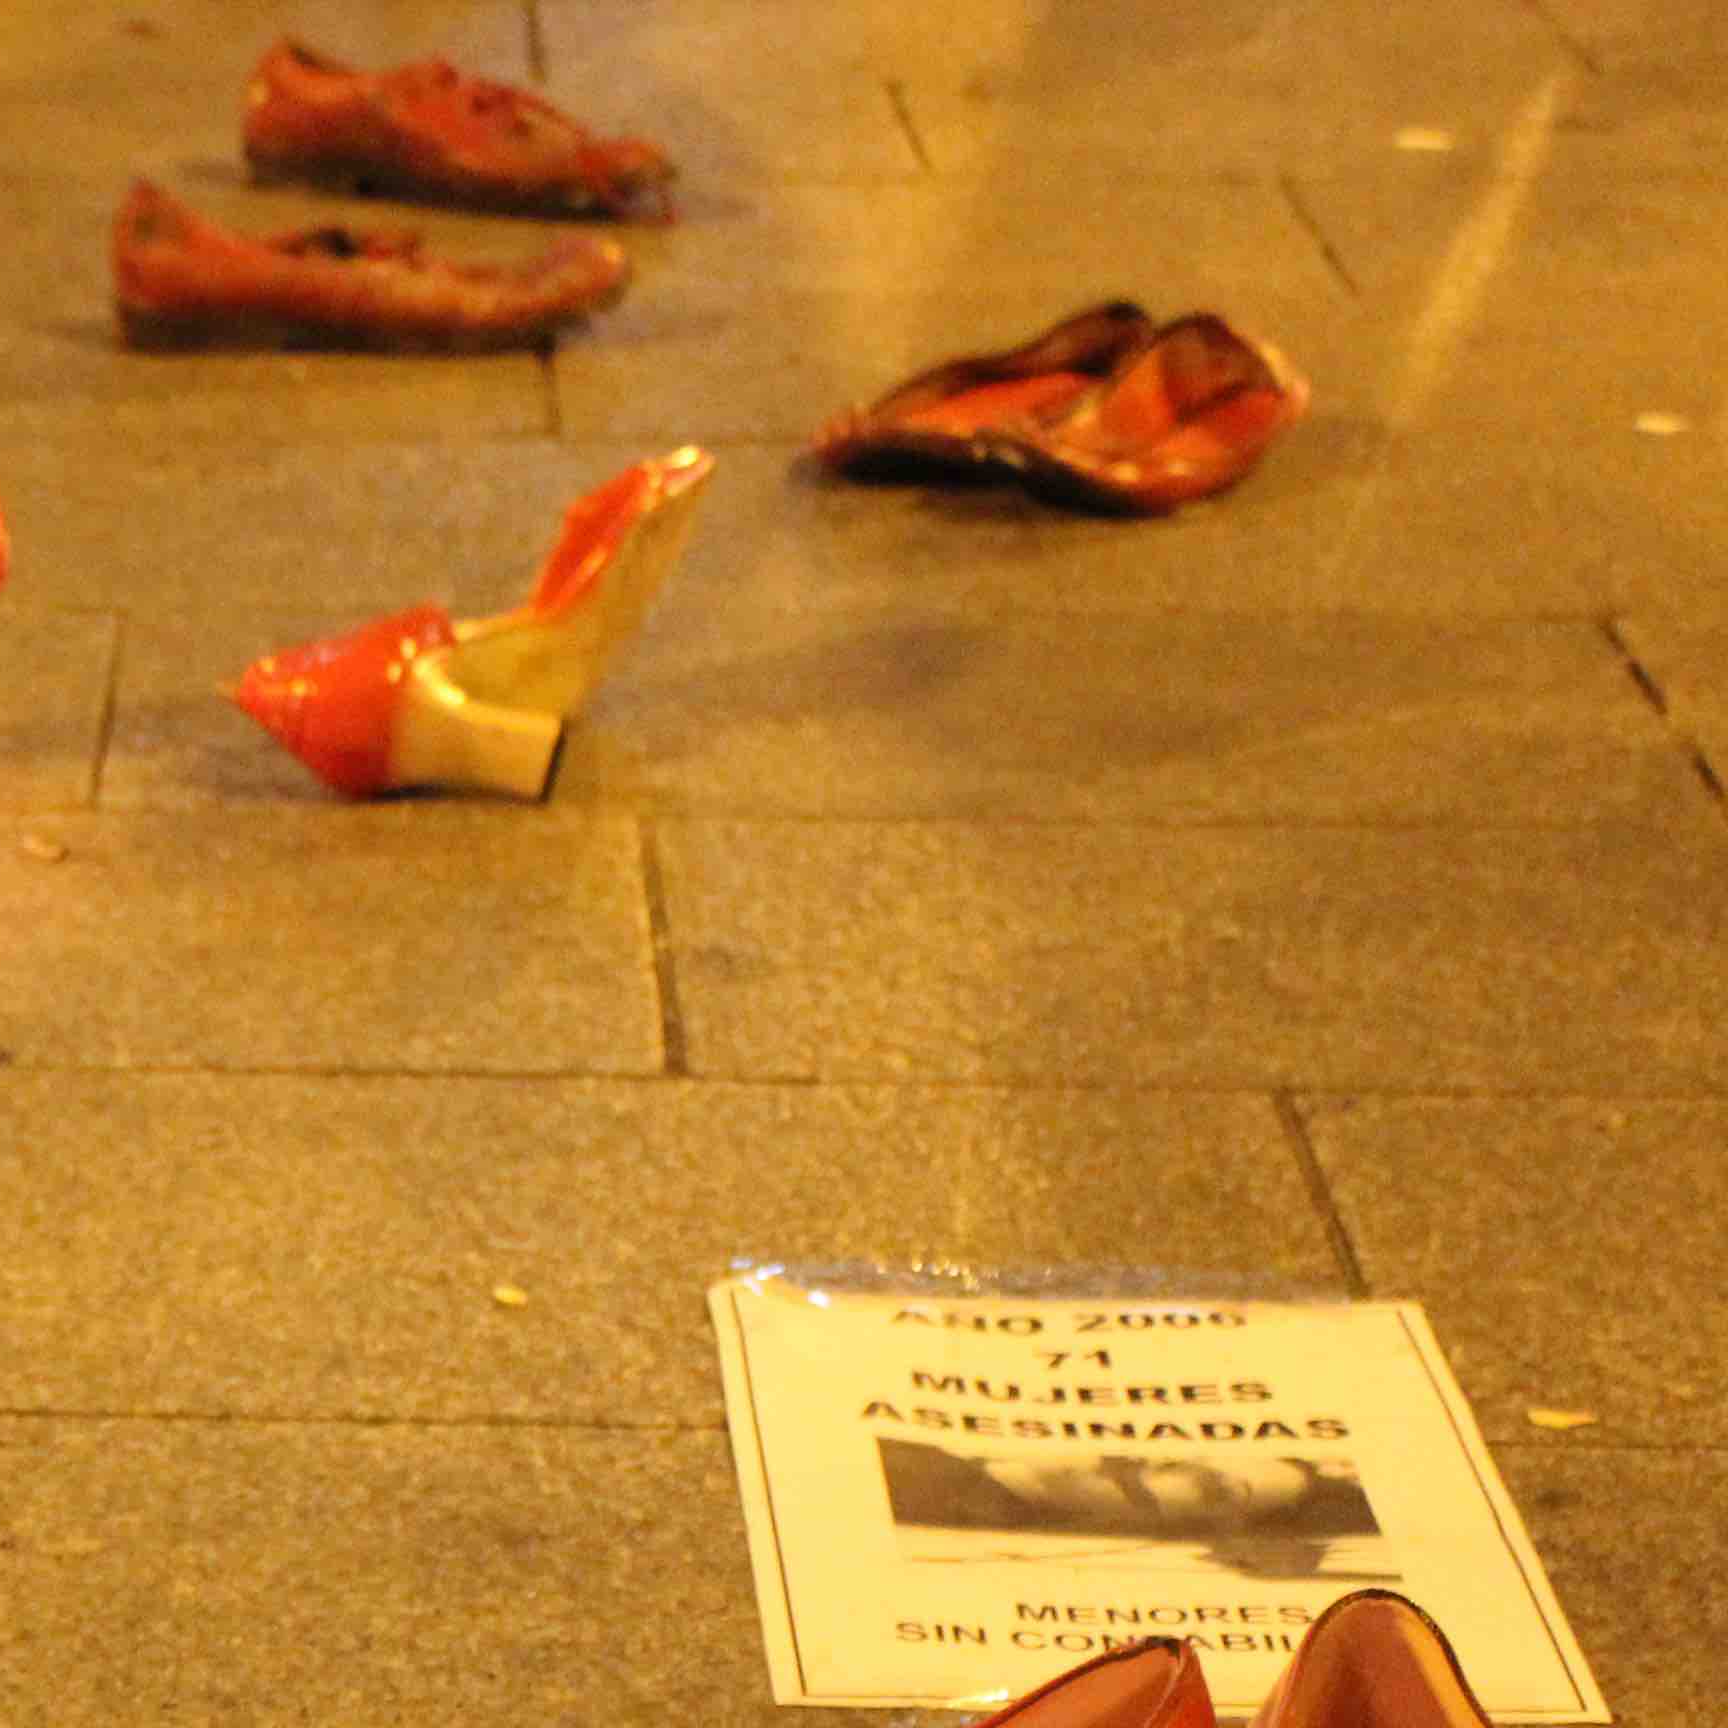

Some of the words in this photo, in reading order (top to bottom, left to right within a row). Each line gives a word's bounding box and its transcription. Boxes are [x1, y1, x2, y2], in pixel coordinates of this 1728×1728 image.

[1038, 1349, 1115, 1370] 71
[908, 1370, 1273, 1405] MUJERES
[860, 1400, 1350, 1441] ASESINADAS
[1014, 1603, 1314, 1626] MENORES
[895, 1621, 987, 1647] SIN
